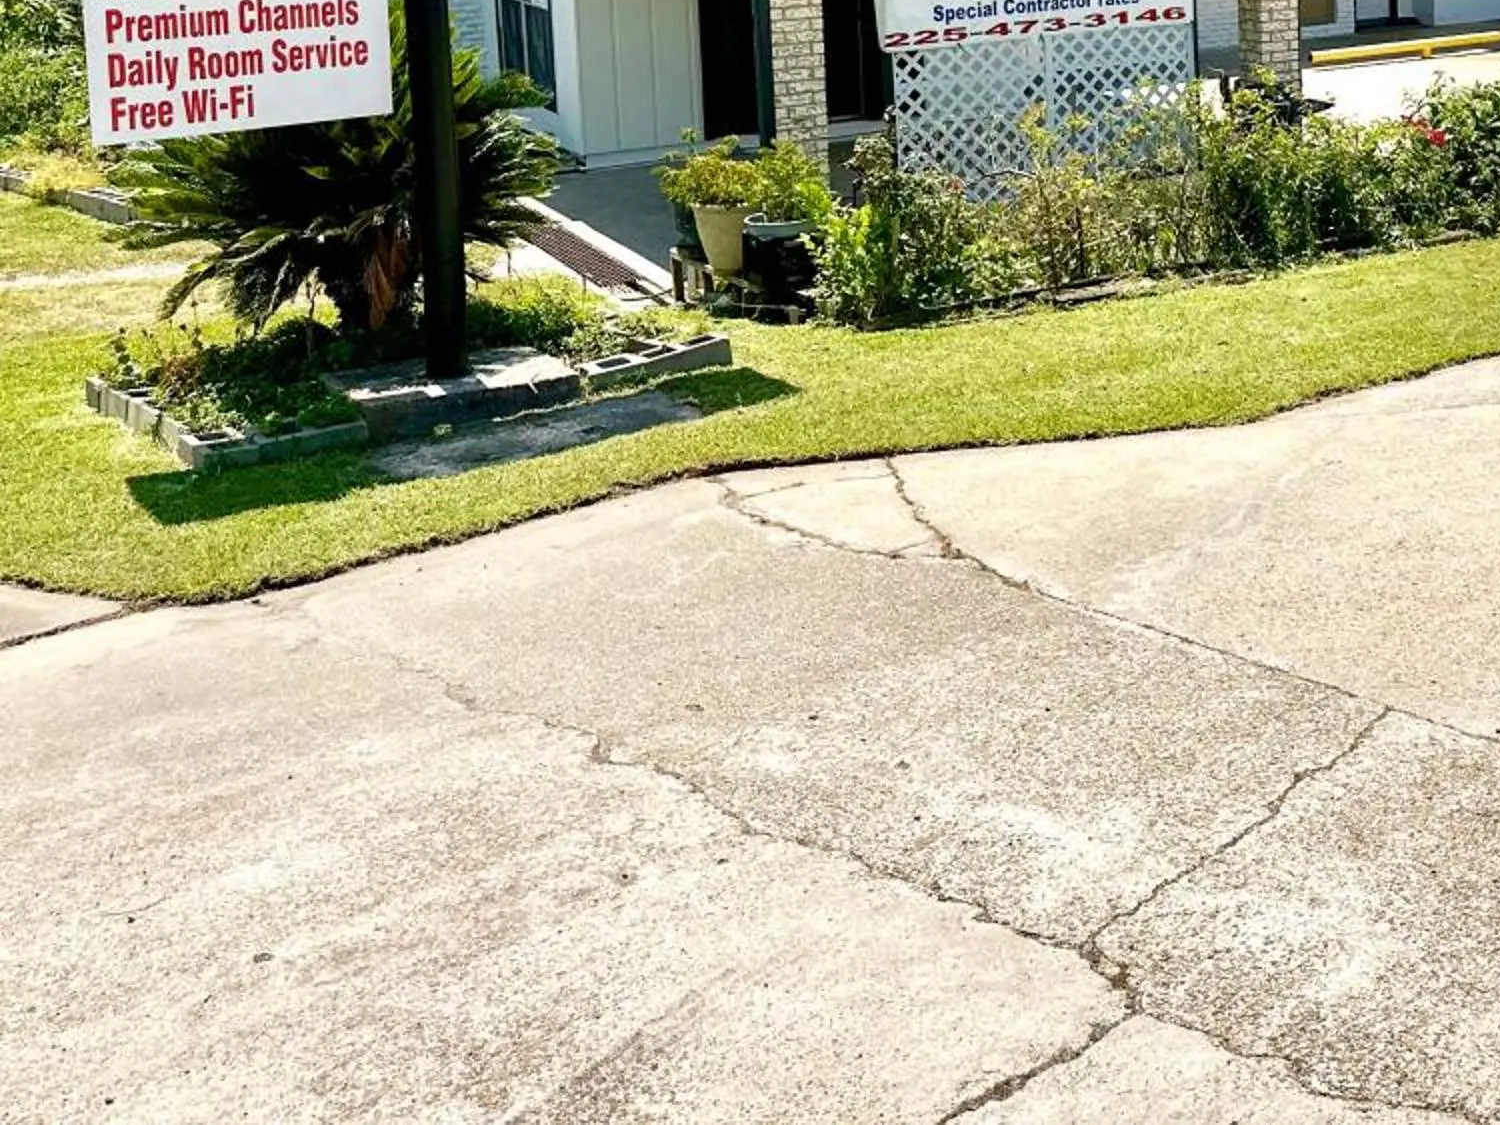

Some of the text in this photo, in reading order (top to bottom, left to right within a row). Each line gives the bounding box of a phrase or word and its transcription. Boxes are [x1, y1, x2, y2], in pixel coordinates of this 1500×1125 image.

[105, 5, 230, 44] Premium
[883, 6, 1187, 48] 225-473-3146
[933, 2, 998, 25] Special
[107, 36, 369, 91] Daily Room Service
[110, 85, 256, 132] Free Wi-Fi
